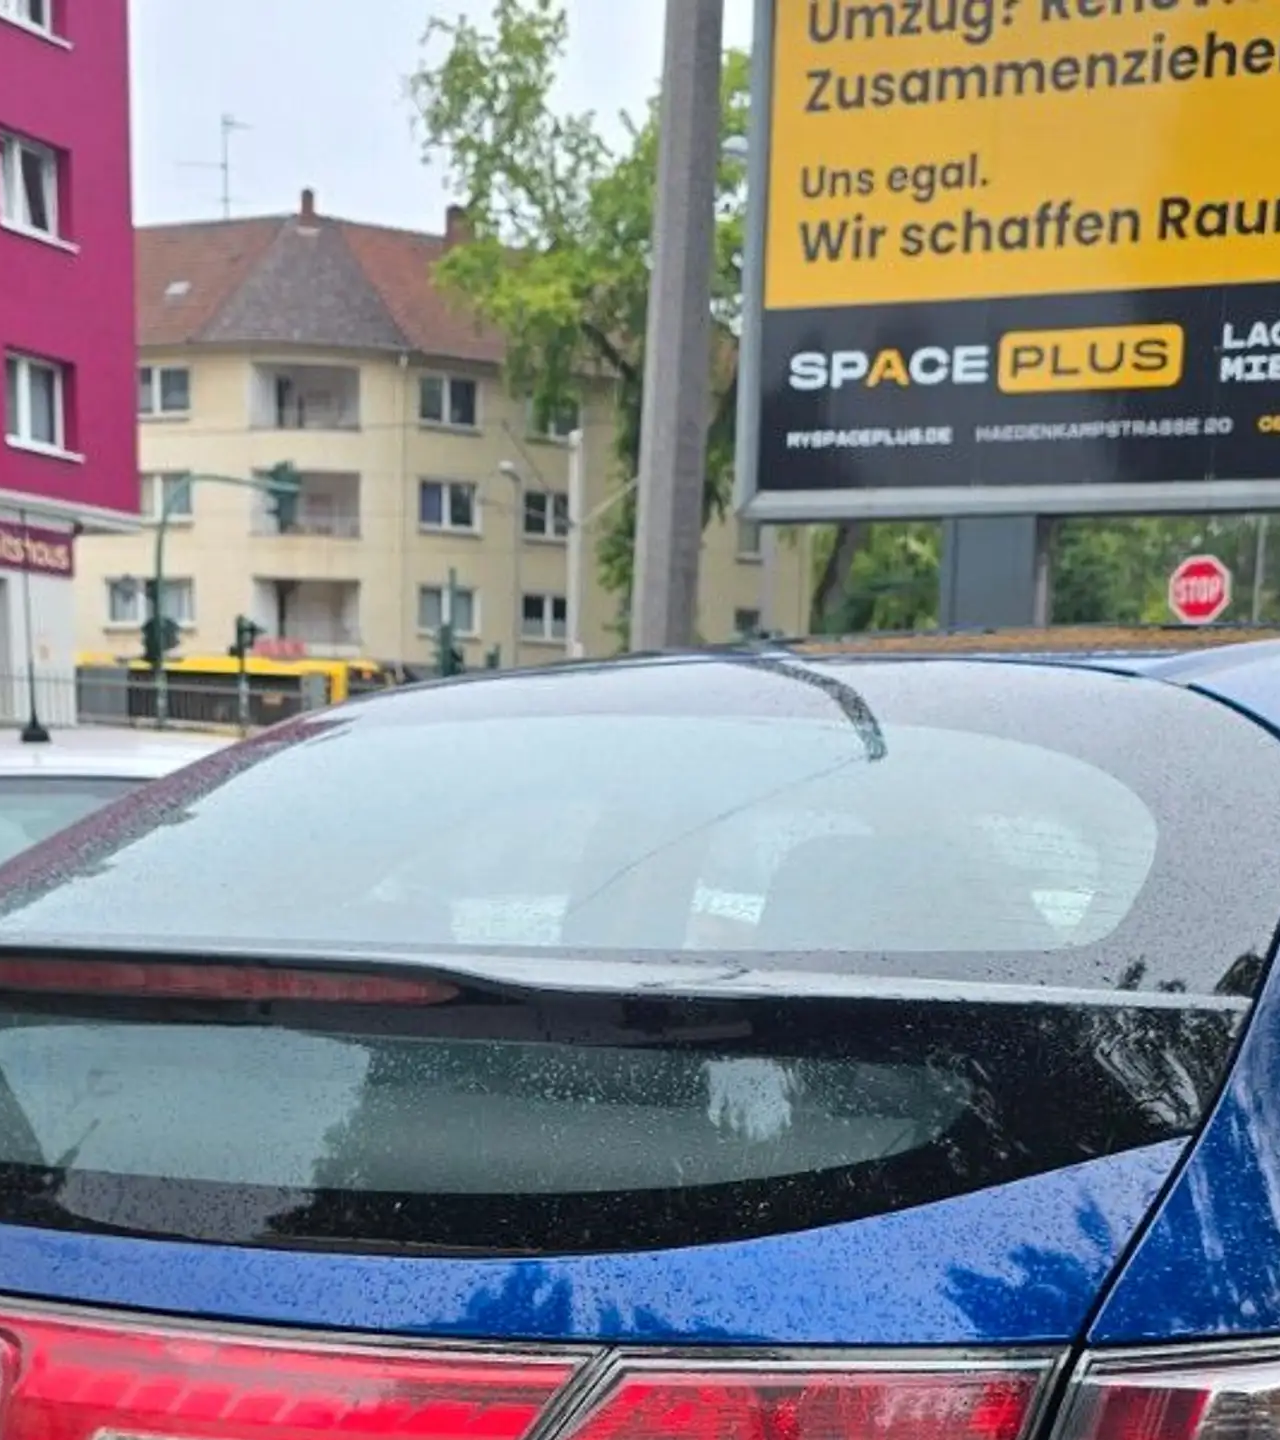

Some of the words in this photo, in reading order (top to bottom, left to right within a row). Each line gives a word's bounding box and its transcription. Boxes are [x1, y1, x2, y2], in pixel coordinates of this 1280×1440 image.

[801, 165, 874, 197] Uns
[887, 153, 989, 203] egal.
[800, 213, 886, 262] Wir
[900, 200, 1141, 257] schaffen
[789, 345, 990, 390] SPACE
[1010, 338, 1169, 379] PLUS
[1174, 576, 1220, 604] STOP
